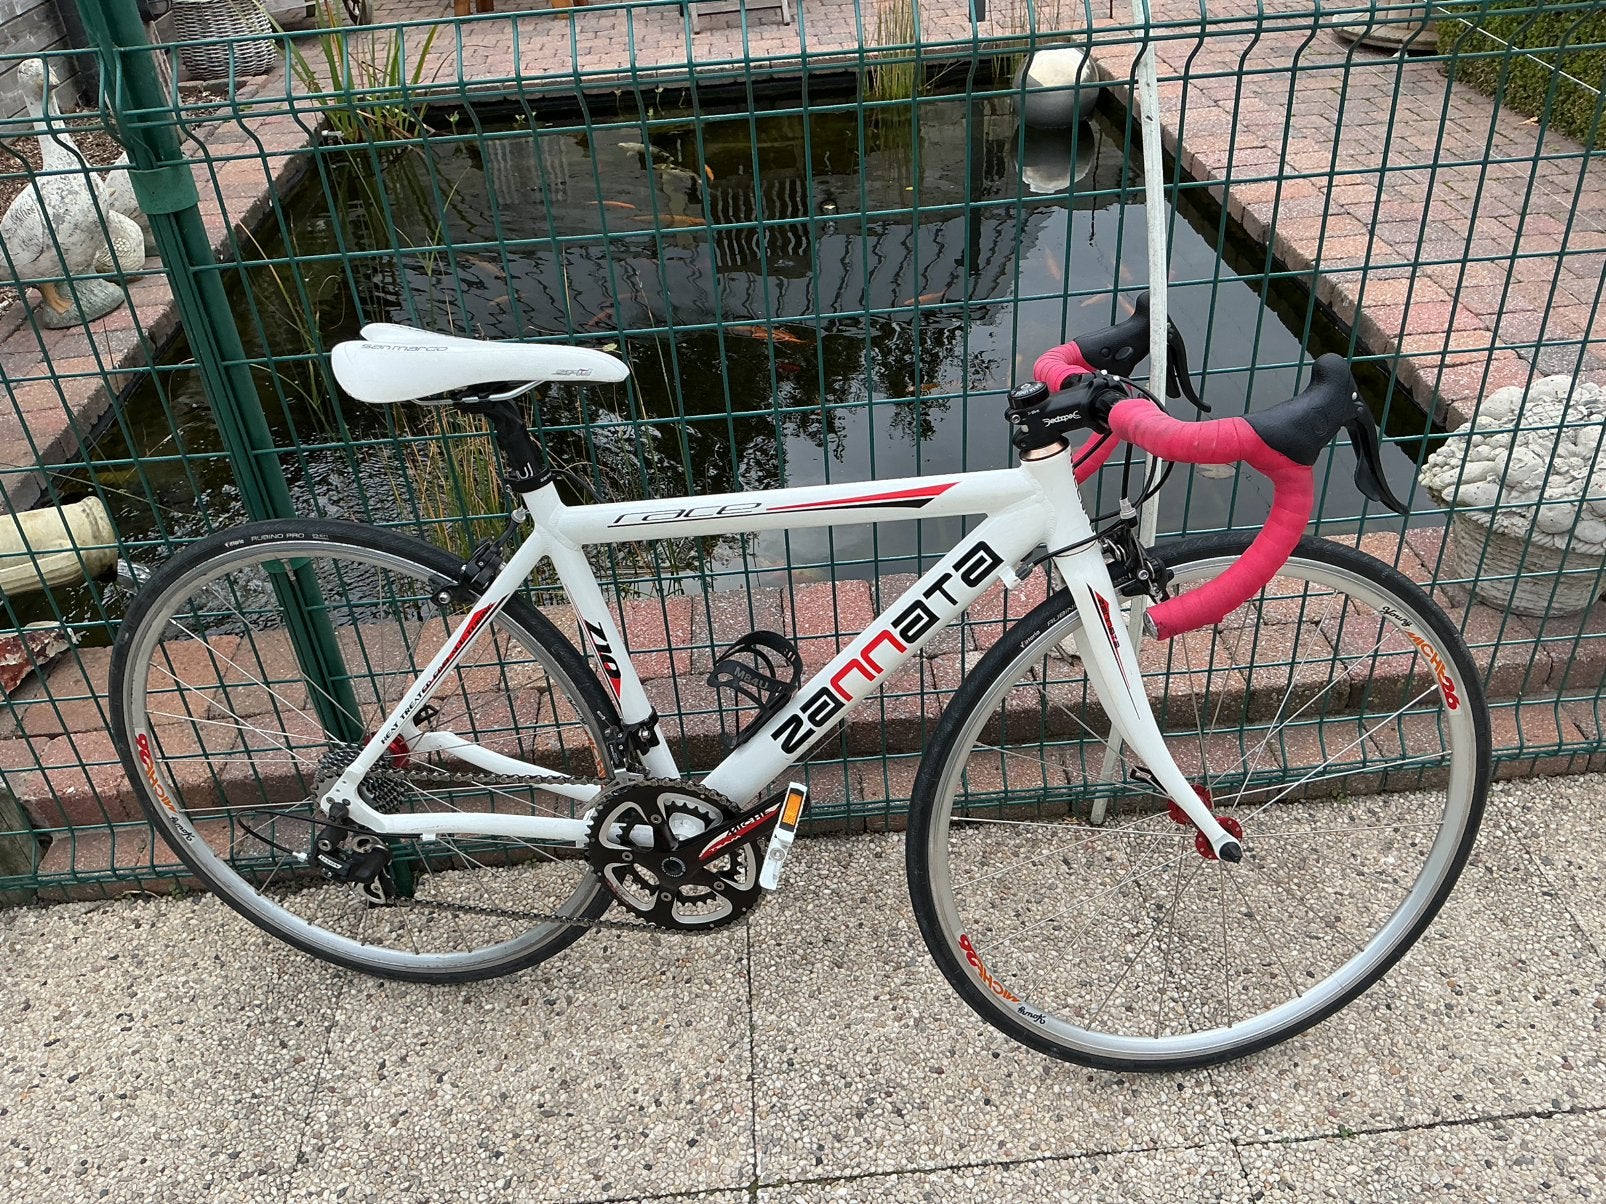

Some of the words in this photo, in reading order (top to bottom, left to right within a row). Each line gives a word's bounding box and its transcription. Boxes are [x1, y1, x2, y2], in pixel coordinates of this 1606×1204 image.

[612, 502, 762, 526] race
[734, 666, 769, 689] M84U
[381, 721, 399, 745] HEAT
[400, 679, 432, 720] TREATED
